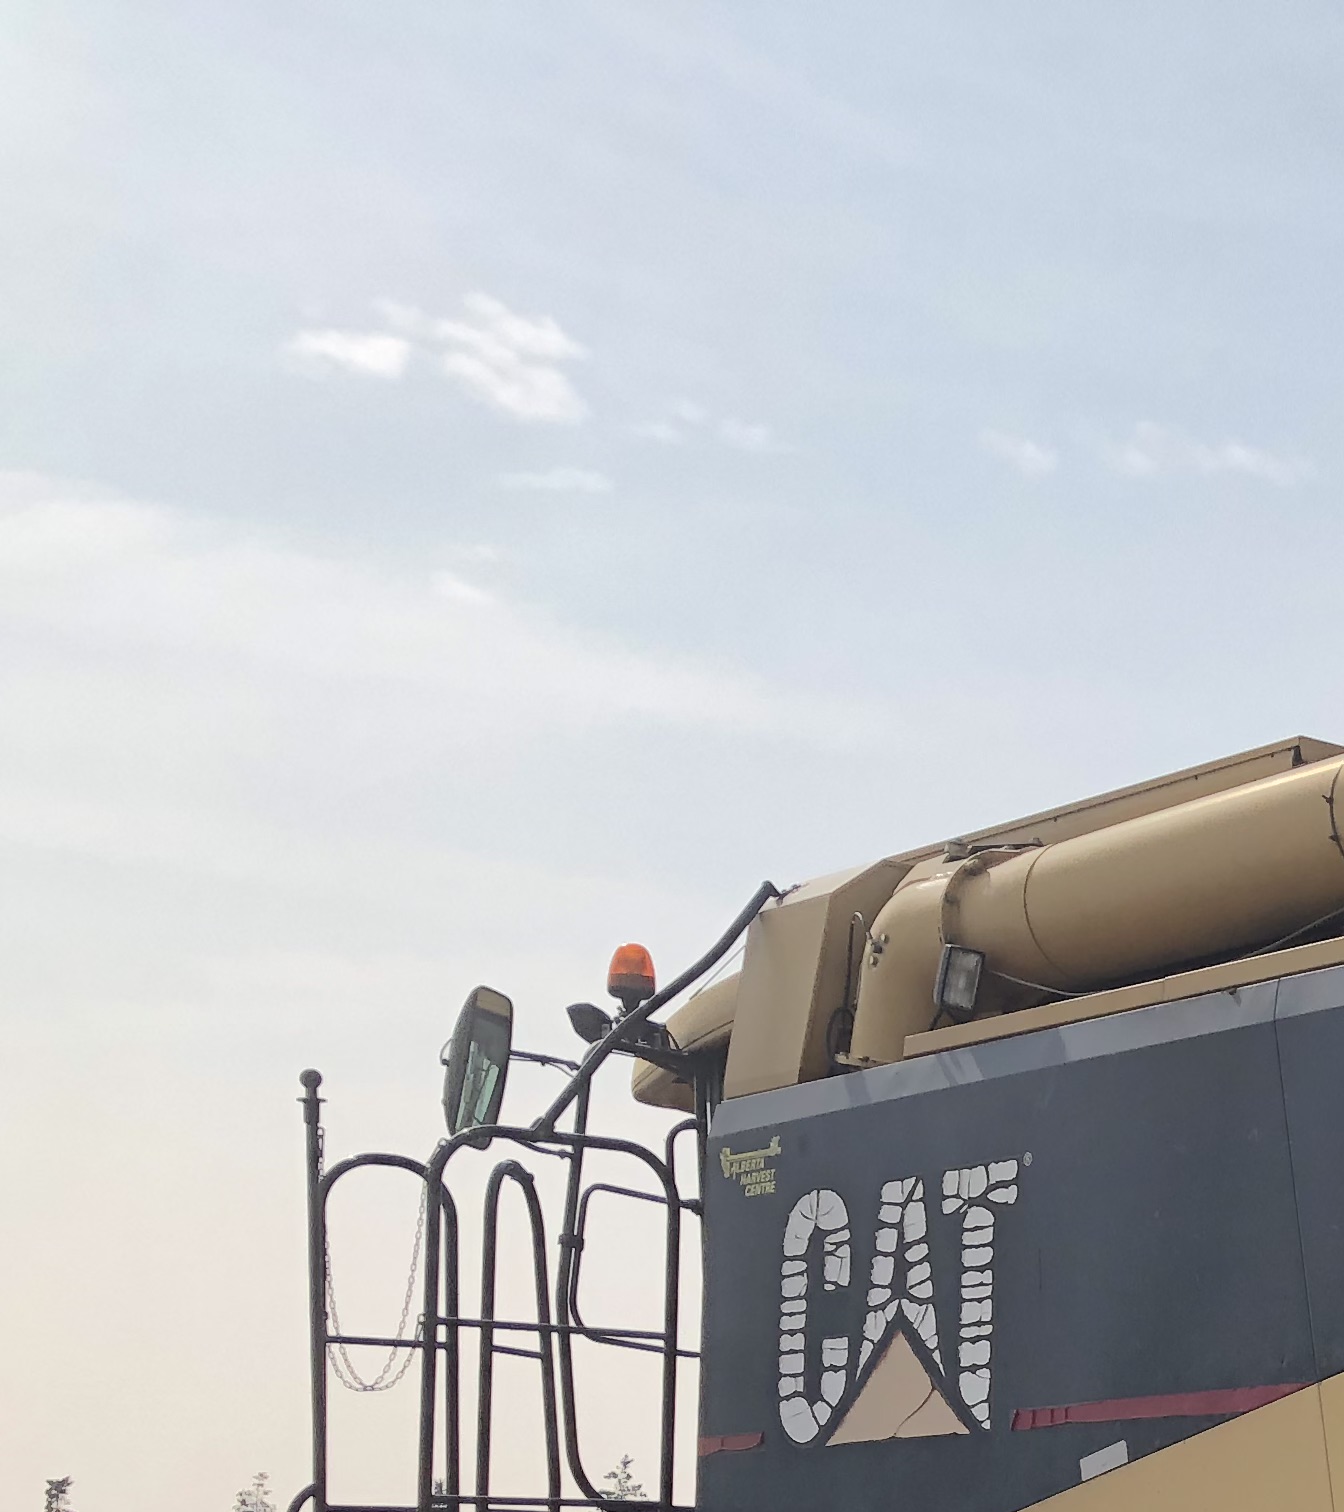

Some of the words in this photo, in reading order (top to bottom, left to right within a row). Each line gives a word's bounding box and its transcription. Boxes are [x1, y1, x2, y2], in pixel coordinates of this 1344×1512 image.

[730, 1157, 765, 1174] ALBERTA
[740, 1168, 776, 1186] HARVEST
[745, 1181, 776, 1197] CENTRE
[777, 1159, 1019, 1445] CAT
